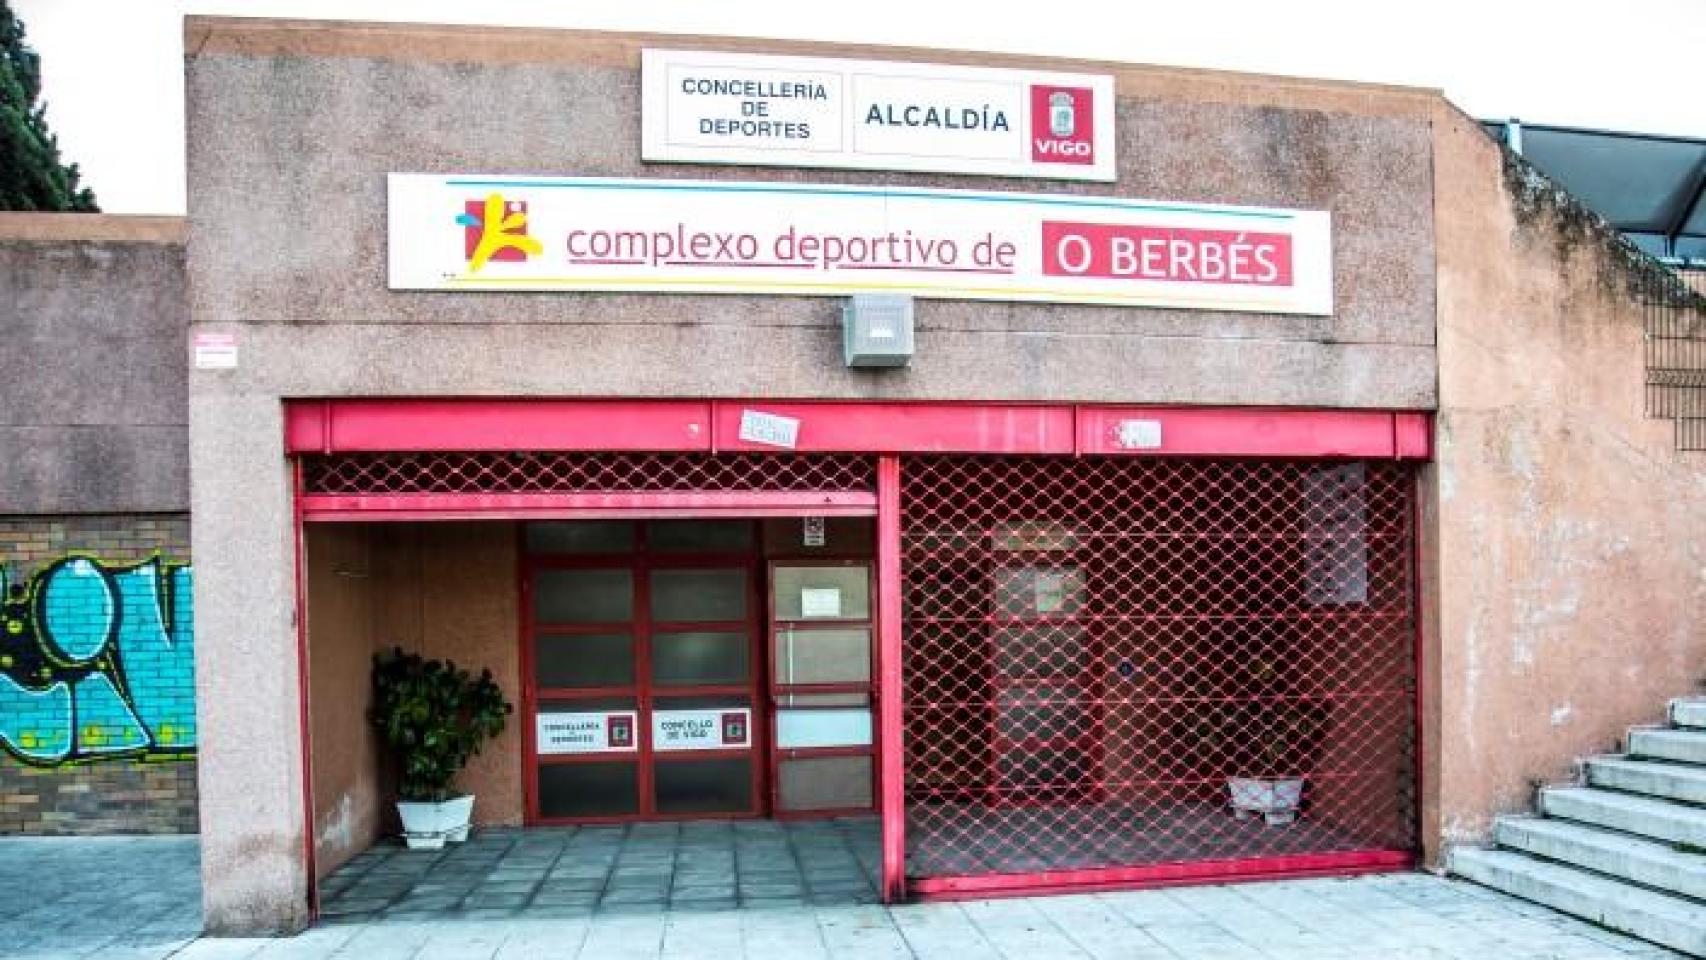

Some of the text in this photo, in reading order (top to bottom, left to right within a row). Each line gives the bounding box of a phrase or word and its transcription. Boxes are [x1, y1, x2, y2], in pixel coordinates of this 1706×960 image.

[682, 78, 827, 101] CONCELLERÍA
[741, 101, 769, 117] DE
[865, 103, 1010, 131] ALCALDÍA
[699, 118, 811, 139] DEPORTES
[1035, 140, 1092, 157] VIGO
[566, 222, 1279, 283] complexo deportivo de O BERBÉS
